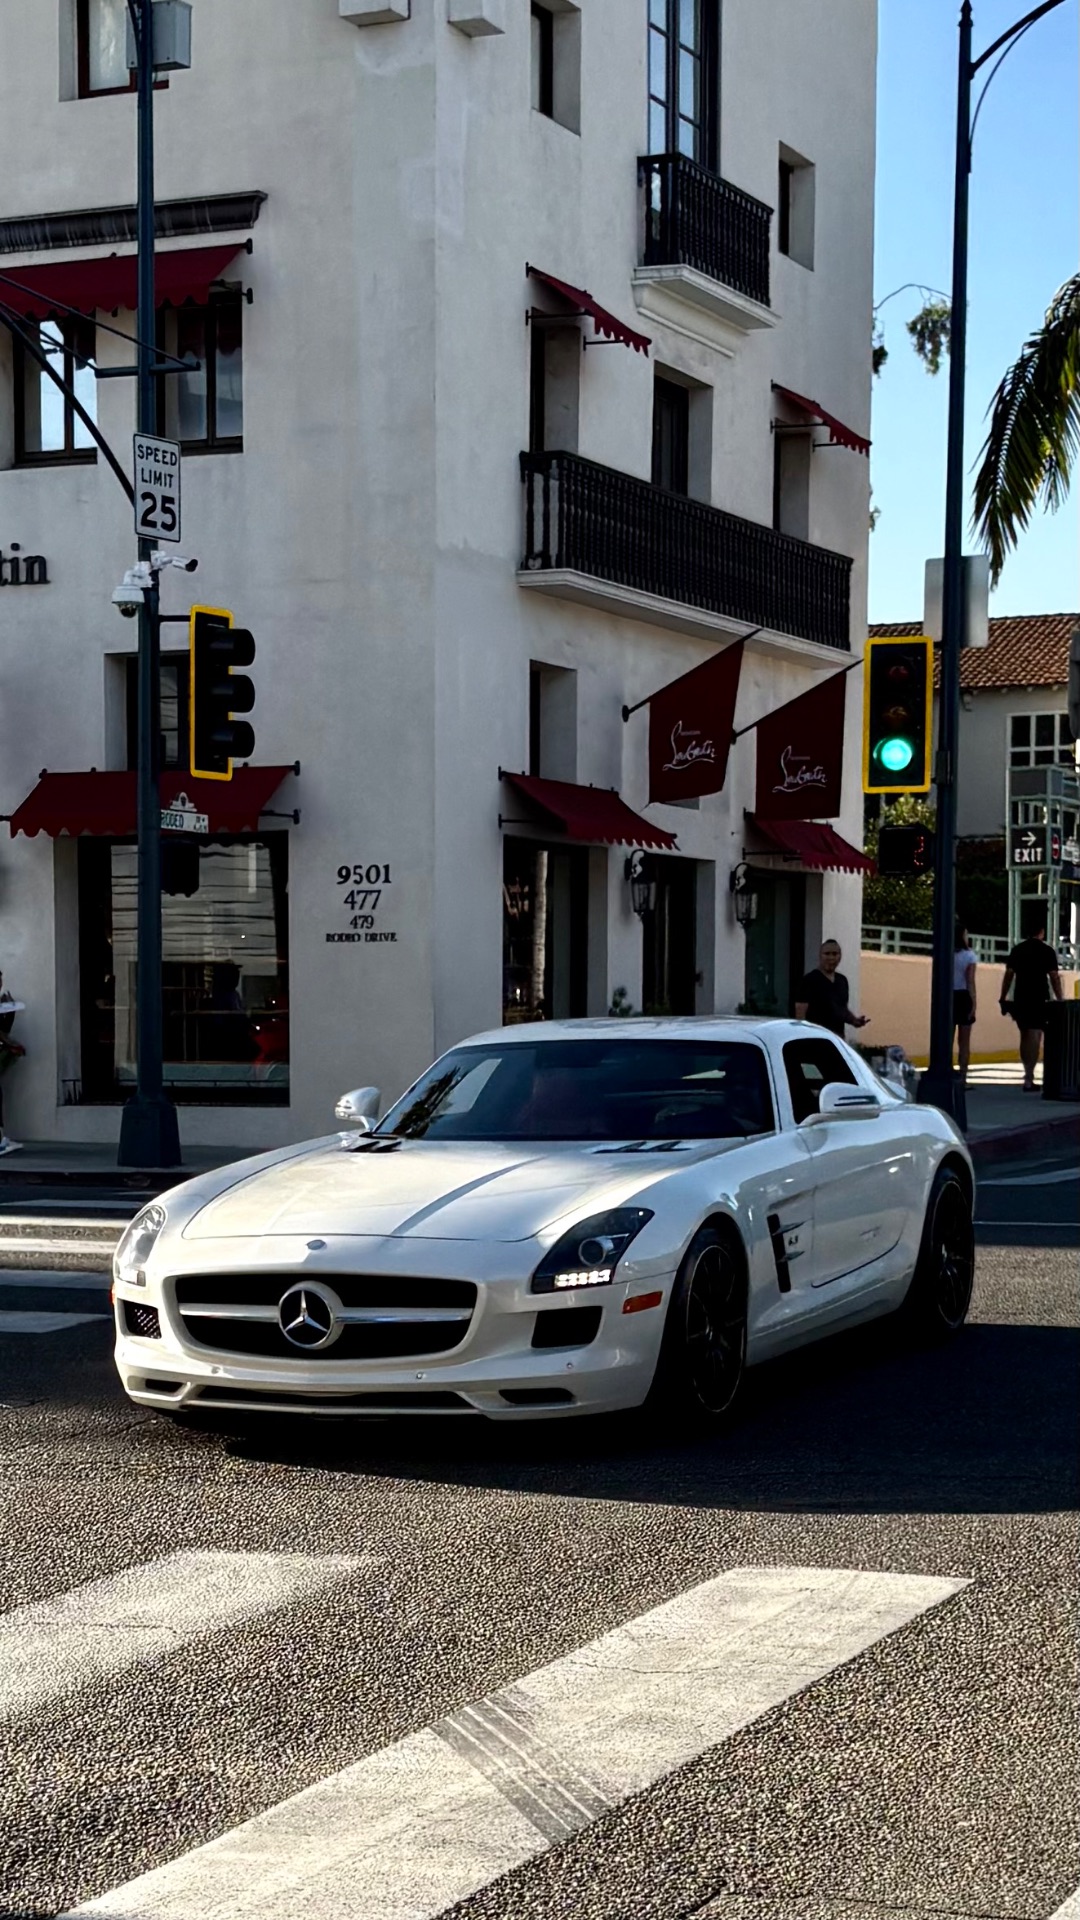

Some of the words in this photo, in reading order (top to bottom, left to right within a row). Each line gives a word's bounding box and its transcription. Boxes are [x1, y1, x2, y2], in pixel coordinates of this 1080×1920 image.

[137, 444, 178, 467] SPEED
[141, 468, 174, 489] LIMIT
[140, 492, 177, 532] 25
[1014, 847, 1043, 863] EXIT
[336, 864, 392, 885] 9501
[343, 889, 382, 911] 477
[349, 914, 375, 930] 479
[325, 932, 361, 943] RODEO
[364, 932, 398, 943] DRIVE
